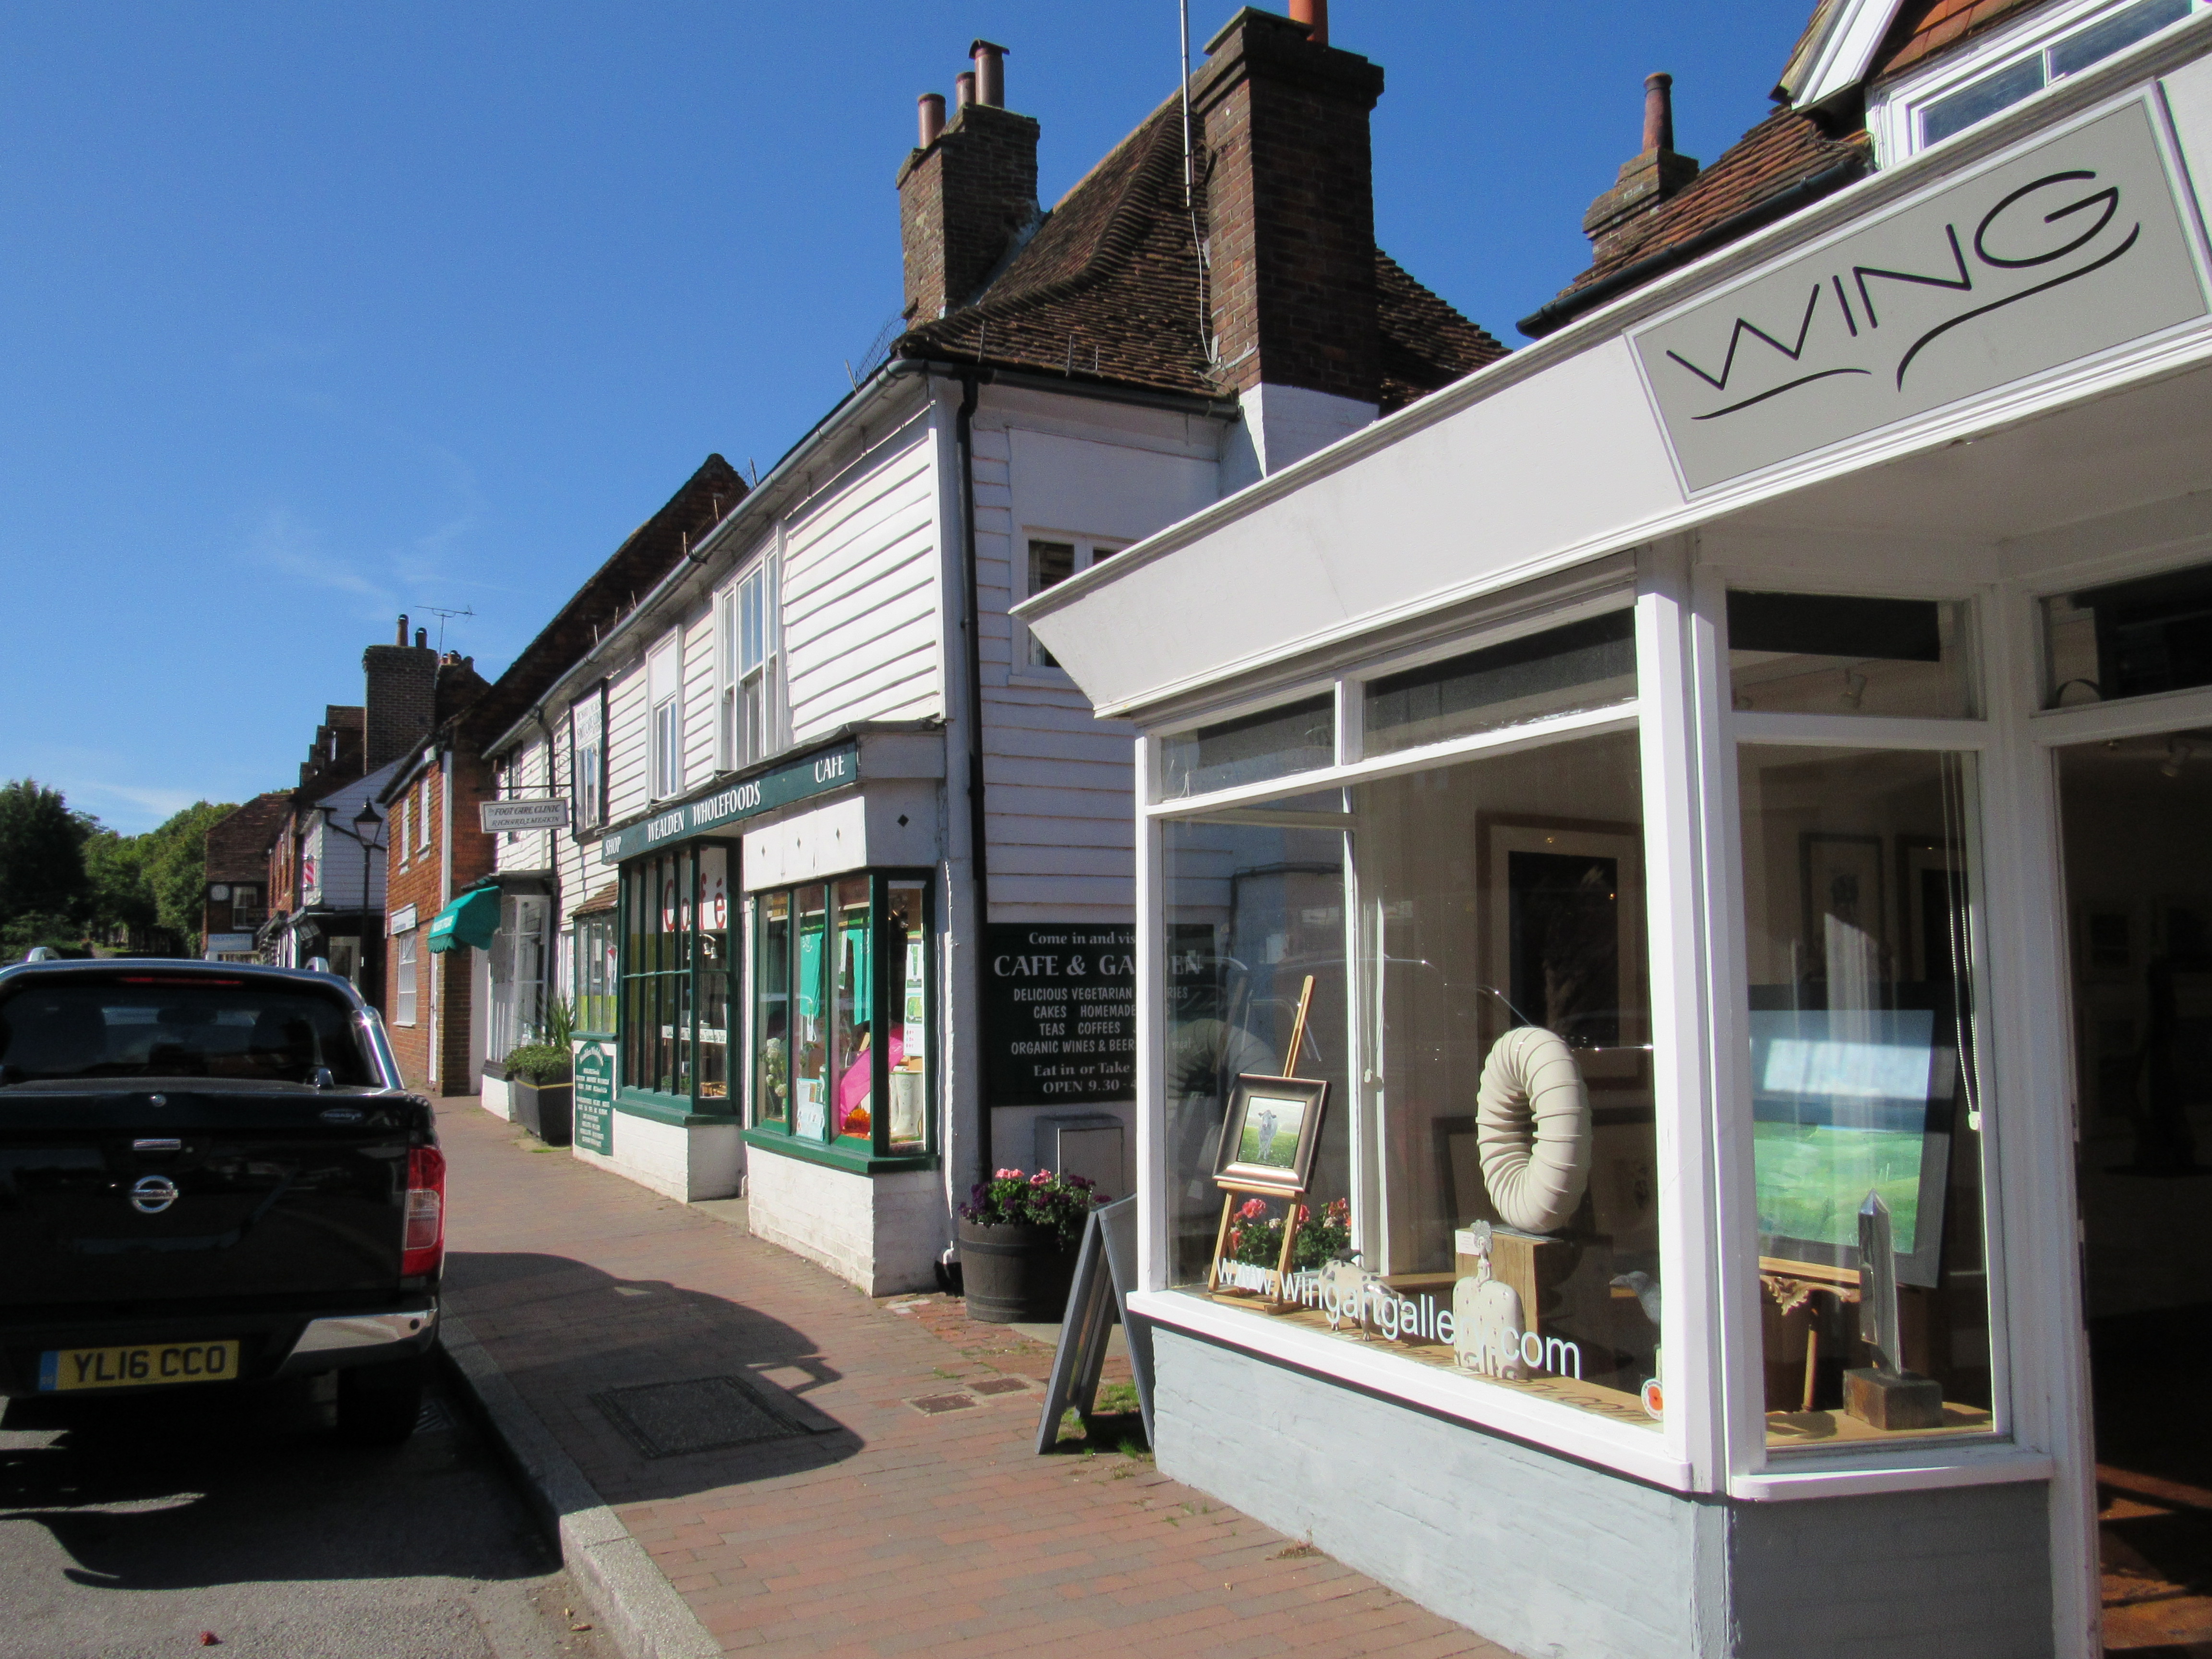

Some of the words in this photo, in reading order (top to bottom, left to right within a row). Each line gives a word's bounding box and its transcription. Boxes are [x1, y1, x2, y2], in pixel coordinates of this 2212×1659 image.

[1666, 170, 2118, 391] WING
[494, 807, 514, 816] FOOT
[515, 806, 534, 815] CARE
[534, 804, 561, 814] CLINIC
[529, 816, 560, 824] MEAKIN
[604, 836, 622, 856] SHOP
[648, 809, 685, 842] WEALDEN
[692, 781, 761, 827] WHOLEFOODS
[1029, 932, 1067, 944] Come
[1072, 932, 1086, 944] in
[1089, 931, 1115, 944] and
[994, 955, 1059, 976] CAFE
[1066, 955, 1087, 975] &
[1014, 988, 1068, 1001] DELICIOUS
[1071, 987, 1132, 1000] VEGETARIAN
[1034, 1005, 1067, 1019] CAKES
[1081, 1004, 1136, 1017] HOMEMADE
[1039, 1023, 1065, 1036] TEAS
[1078, 1022, 1120, 1034] COFFEES
[1011, 1041, 1058, 1055] ORGANIC
[1062, 1040, 1094, 1053] WINES
[1098, 1039, 1106, 1052] &
[1109, 1039, 1136, 1051] BEER
[1034, 1065, 1056, 1077] Eat
[1060, 1064, 1075, 1075] in
[1080, 1065, 1094, 1075] or
[1098, 1061, 1130, 1074] Take
[1043, 1081, 1082, 1094] OPEN
[1088, 1079, 1119, 1092] 9.30
[1216, 1255, 1581, 1381] www.wingartgallery.com
[73, 1350, 150, 1382] YL16
[161, 1345, 226, 1377] CCO
